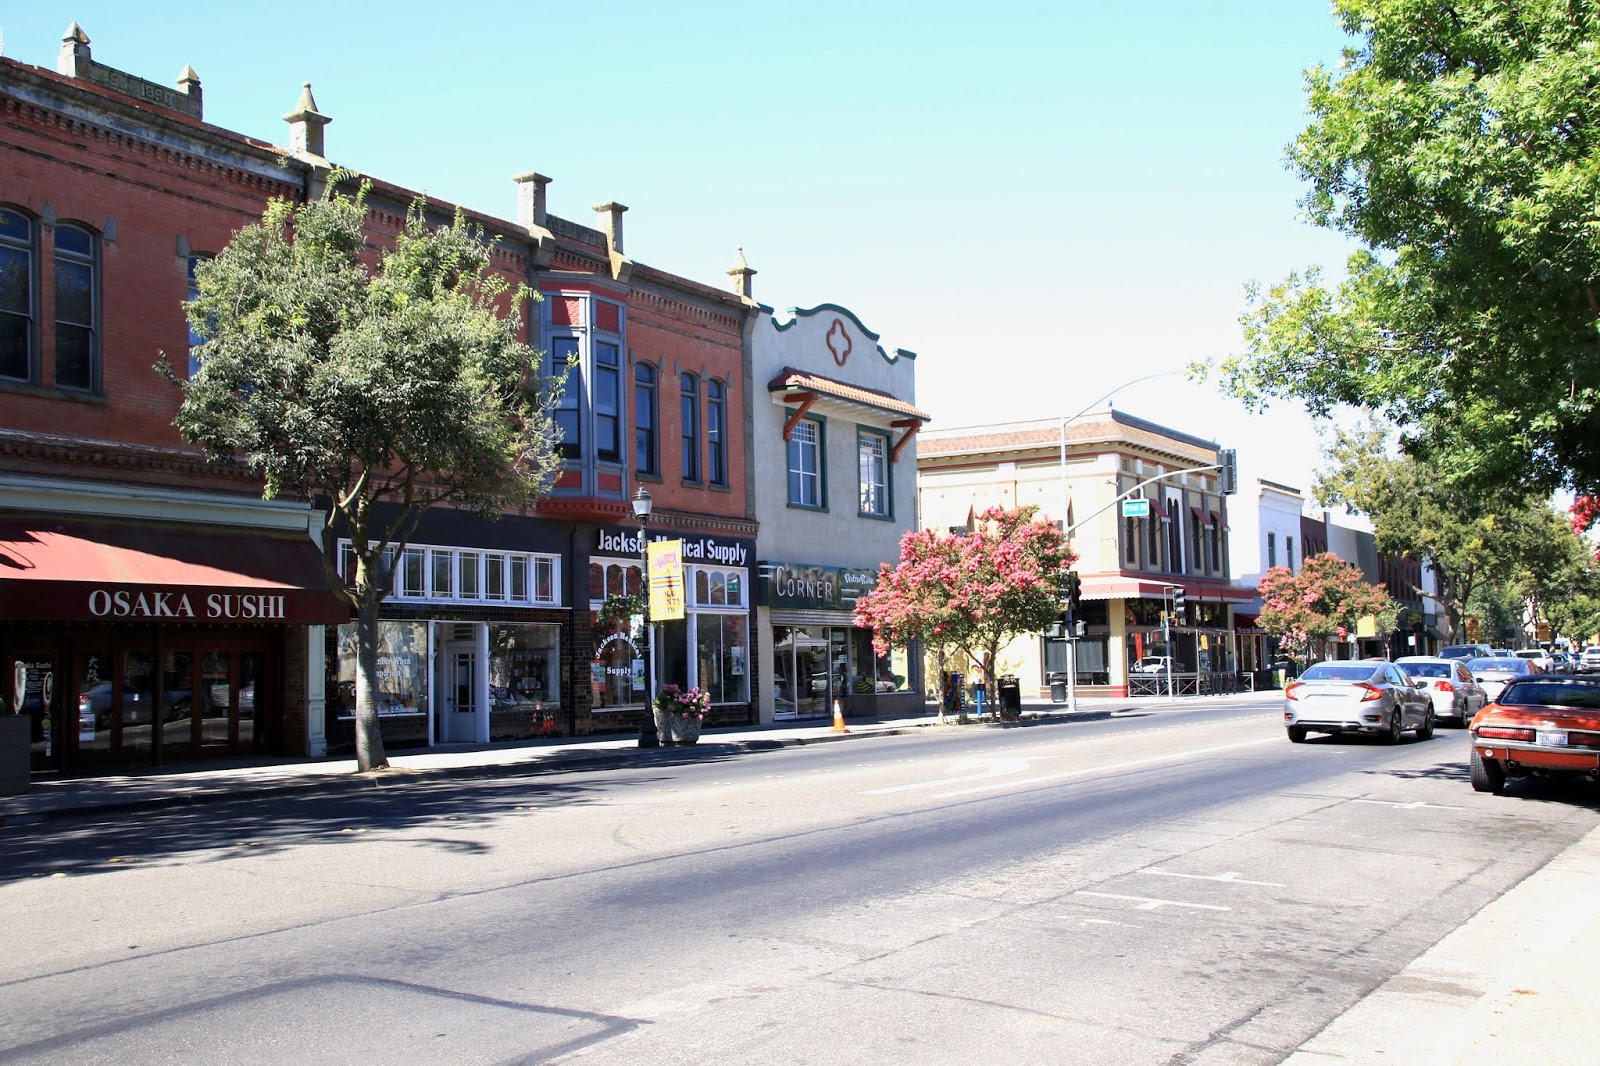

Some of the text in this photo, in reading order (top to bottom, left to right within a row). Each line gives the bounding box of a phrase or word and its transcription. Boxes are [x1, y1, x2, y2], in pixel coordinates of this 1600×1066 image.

[707, 539, 747, 566] Supply
[777, 566, 832, 598] CORNER
[88, 589, 286, 619] OSAKA SUSHI
[595, 633, 618, 659] Jackson
[35, 660, 52, 669] Sushi
[607, 667, 631, 676] Supply
